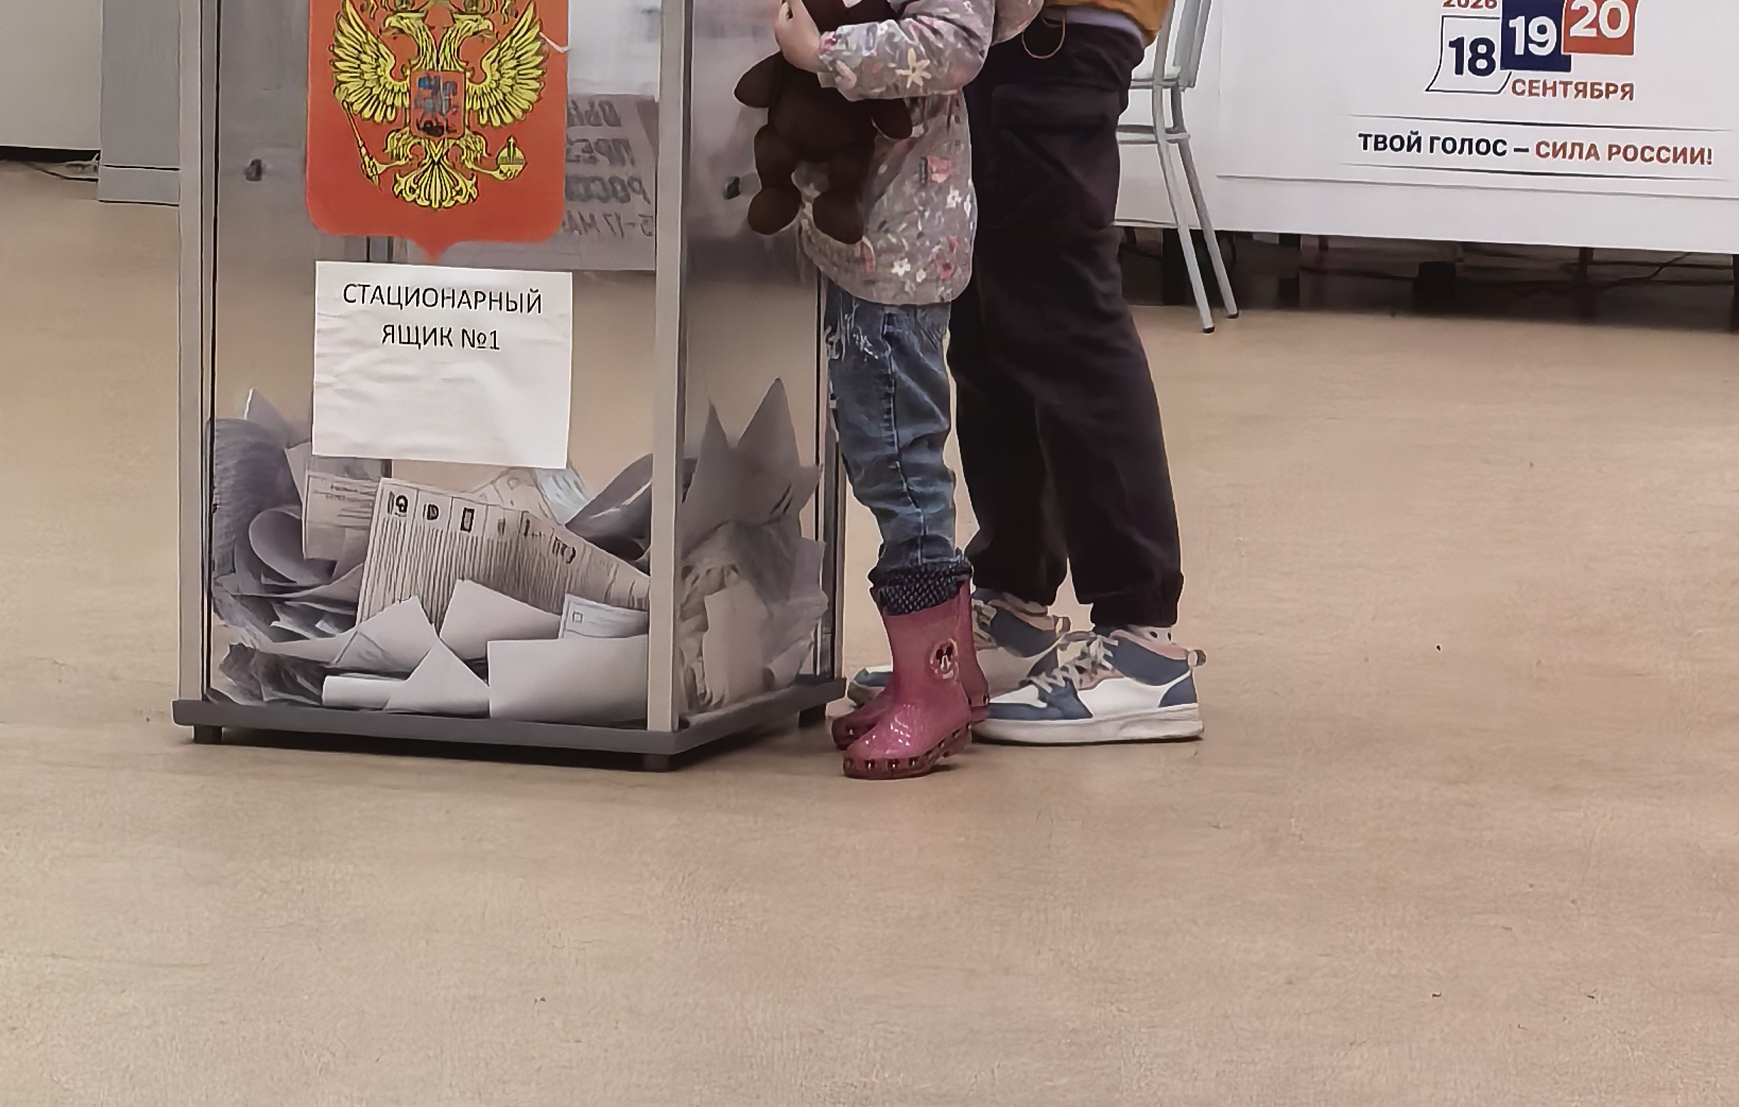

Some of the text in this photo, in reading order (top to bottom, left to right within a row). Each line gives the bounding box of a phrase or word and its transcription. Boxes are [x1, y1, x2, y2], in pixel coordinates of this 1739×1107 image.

[1508, 15, 1557, 56] 19
[1448, 36, 1496, 76] 18
[1510, 78, 1635, 101] СЕНТЯБРЯ
[1358, 130, 1422, 153] ТВОЙ
[1429, 135, 1508, 157] ГОЛОС
[1534, 140, 1601, 162] СИЛА
[1606, 144, 1713, 166] РОССИИ!
[342, 283, 543, 314] СТАЦИОНАРНЫЙ
[381, 324, 501, 350] ЯЩИК №1
